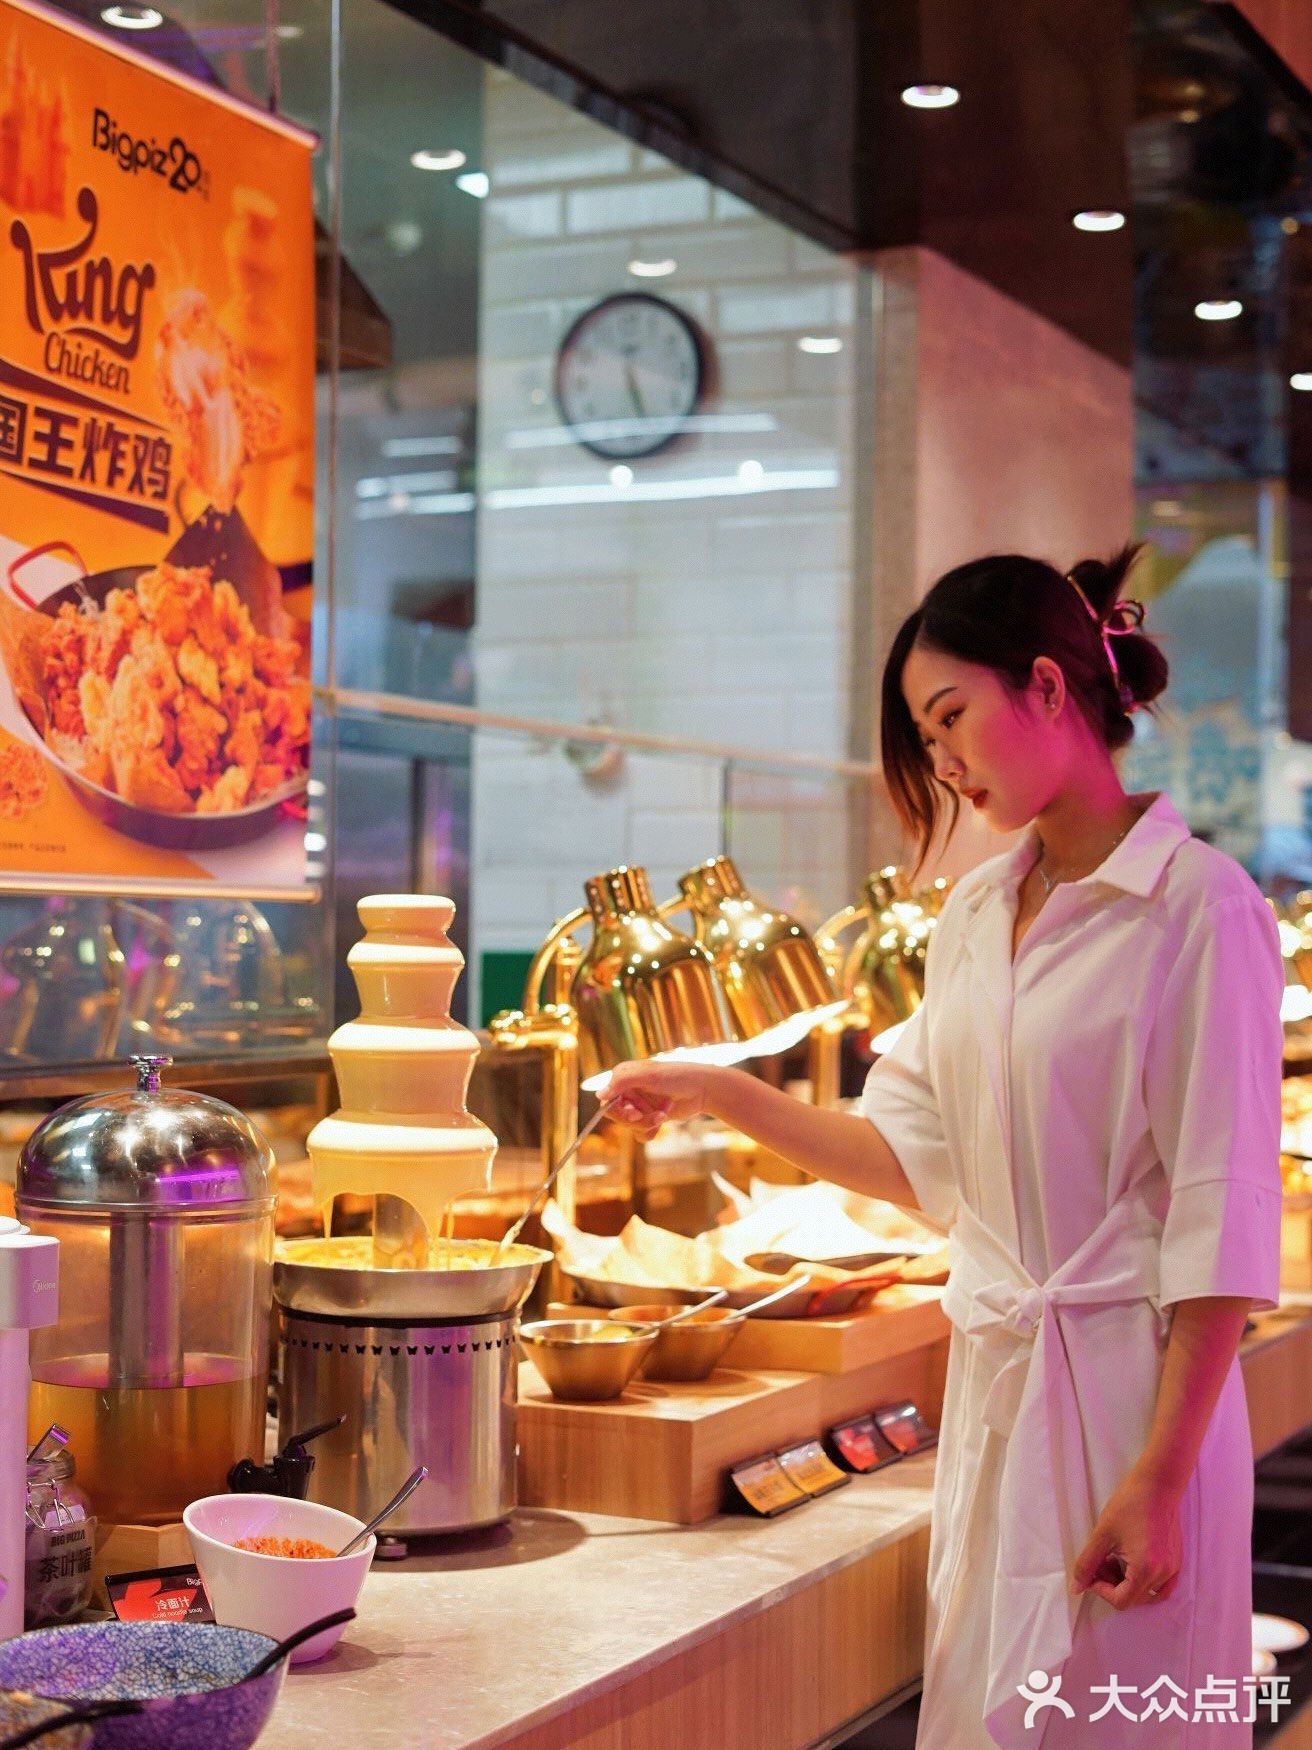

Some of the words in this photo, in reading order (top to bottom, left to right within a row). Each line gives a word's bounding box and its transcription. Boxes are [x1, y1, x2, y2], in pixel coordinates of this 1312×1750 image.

[10, 187, 156, 361] King
[45, 331, 131, 395] Chicken
[0, 394, 173, 500] 国王炸鸡
[155, 1596, 190, 1610] 冷面汁
